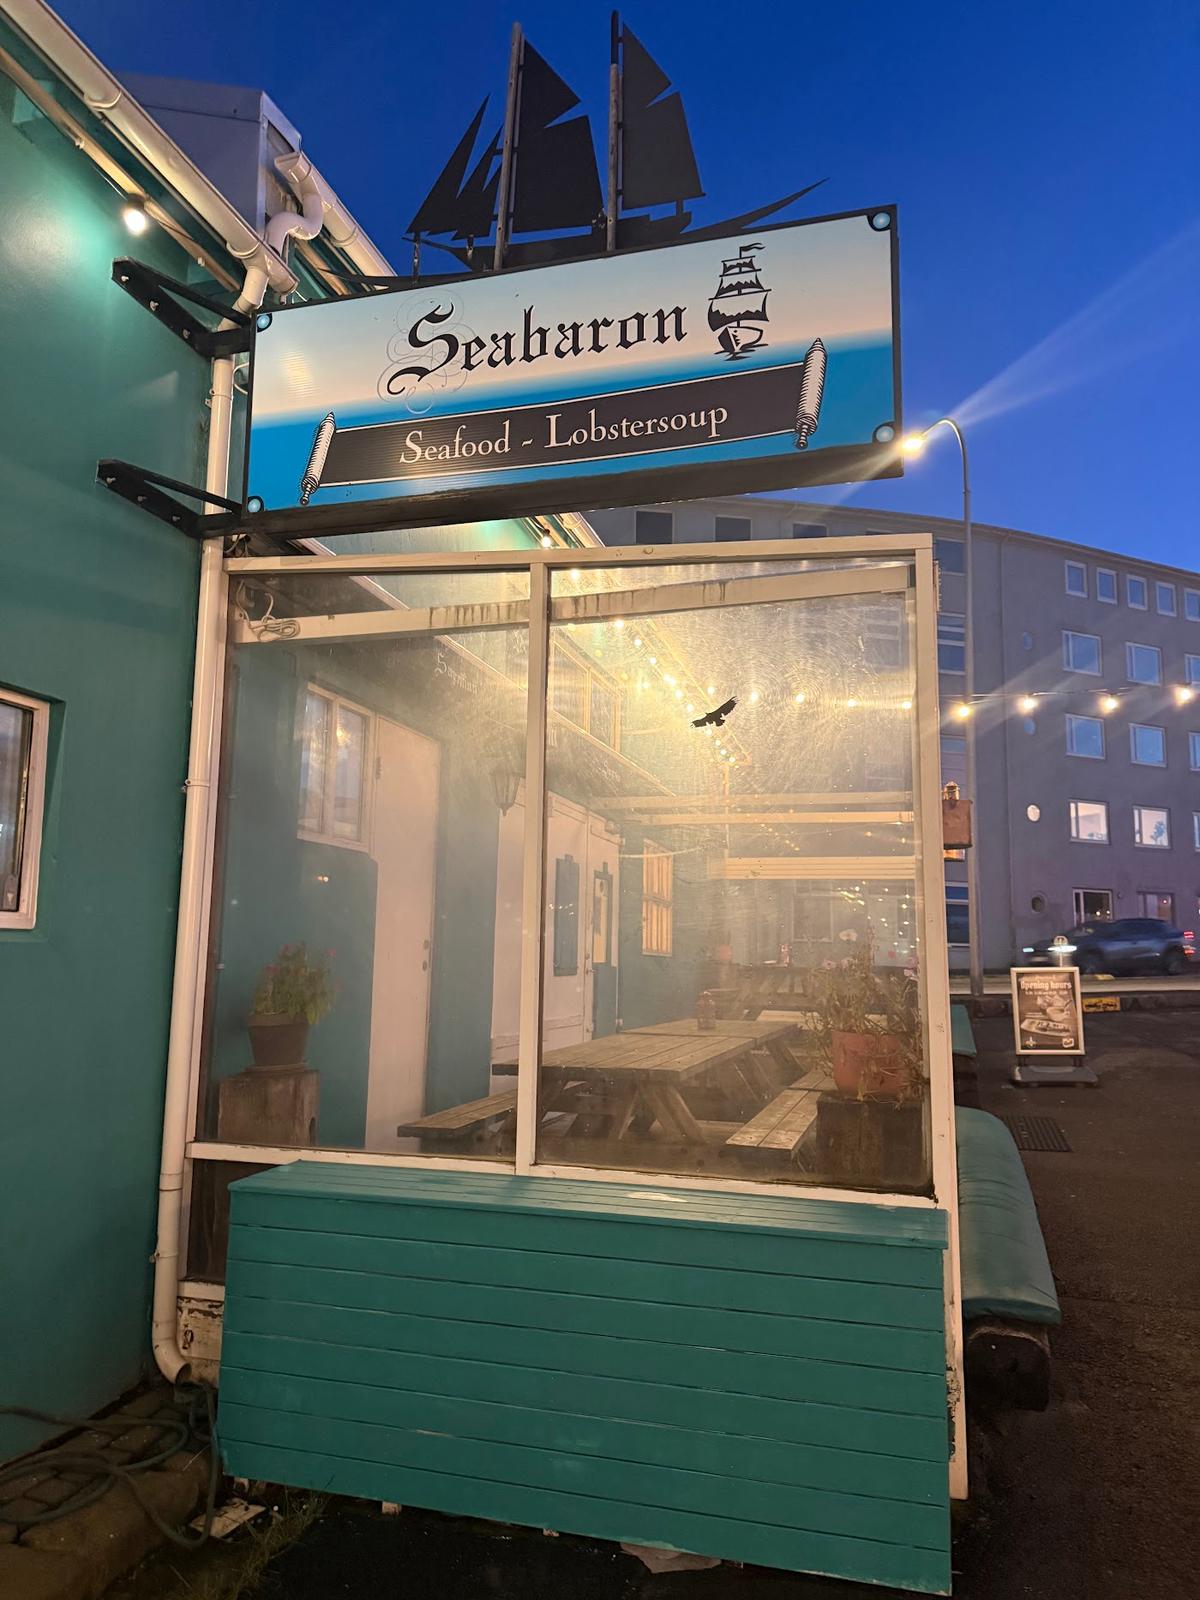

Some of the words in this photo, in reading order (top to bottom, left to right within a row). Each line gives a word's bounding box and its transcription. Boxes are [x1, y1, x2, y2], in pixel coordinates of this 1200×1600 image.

[386, 301, 688, 395] Seabaron
[399, 419, 512, 464] Seafood
[544, 405, 729, 449] Lobstersoup
